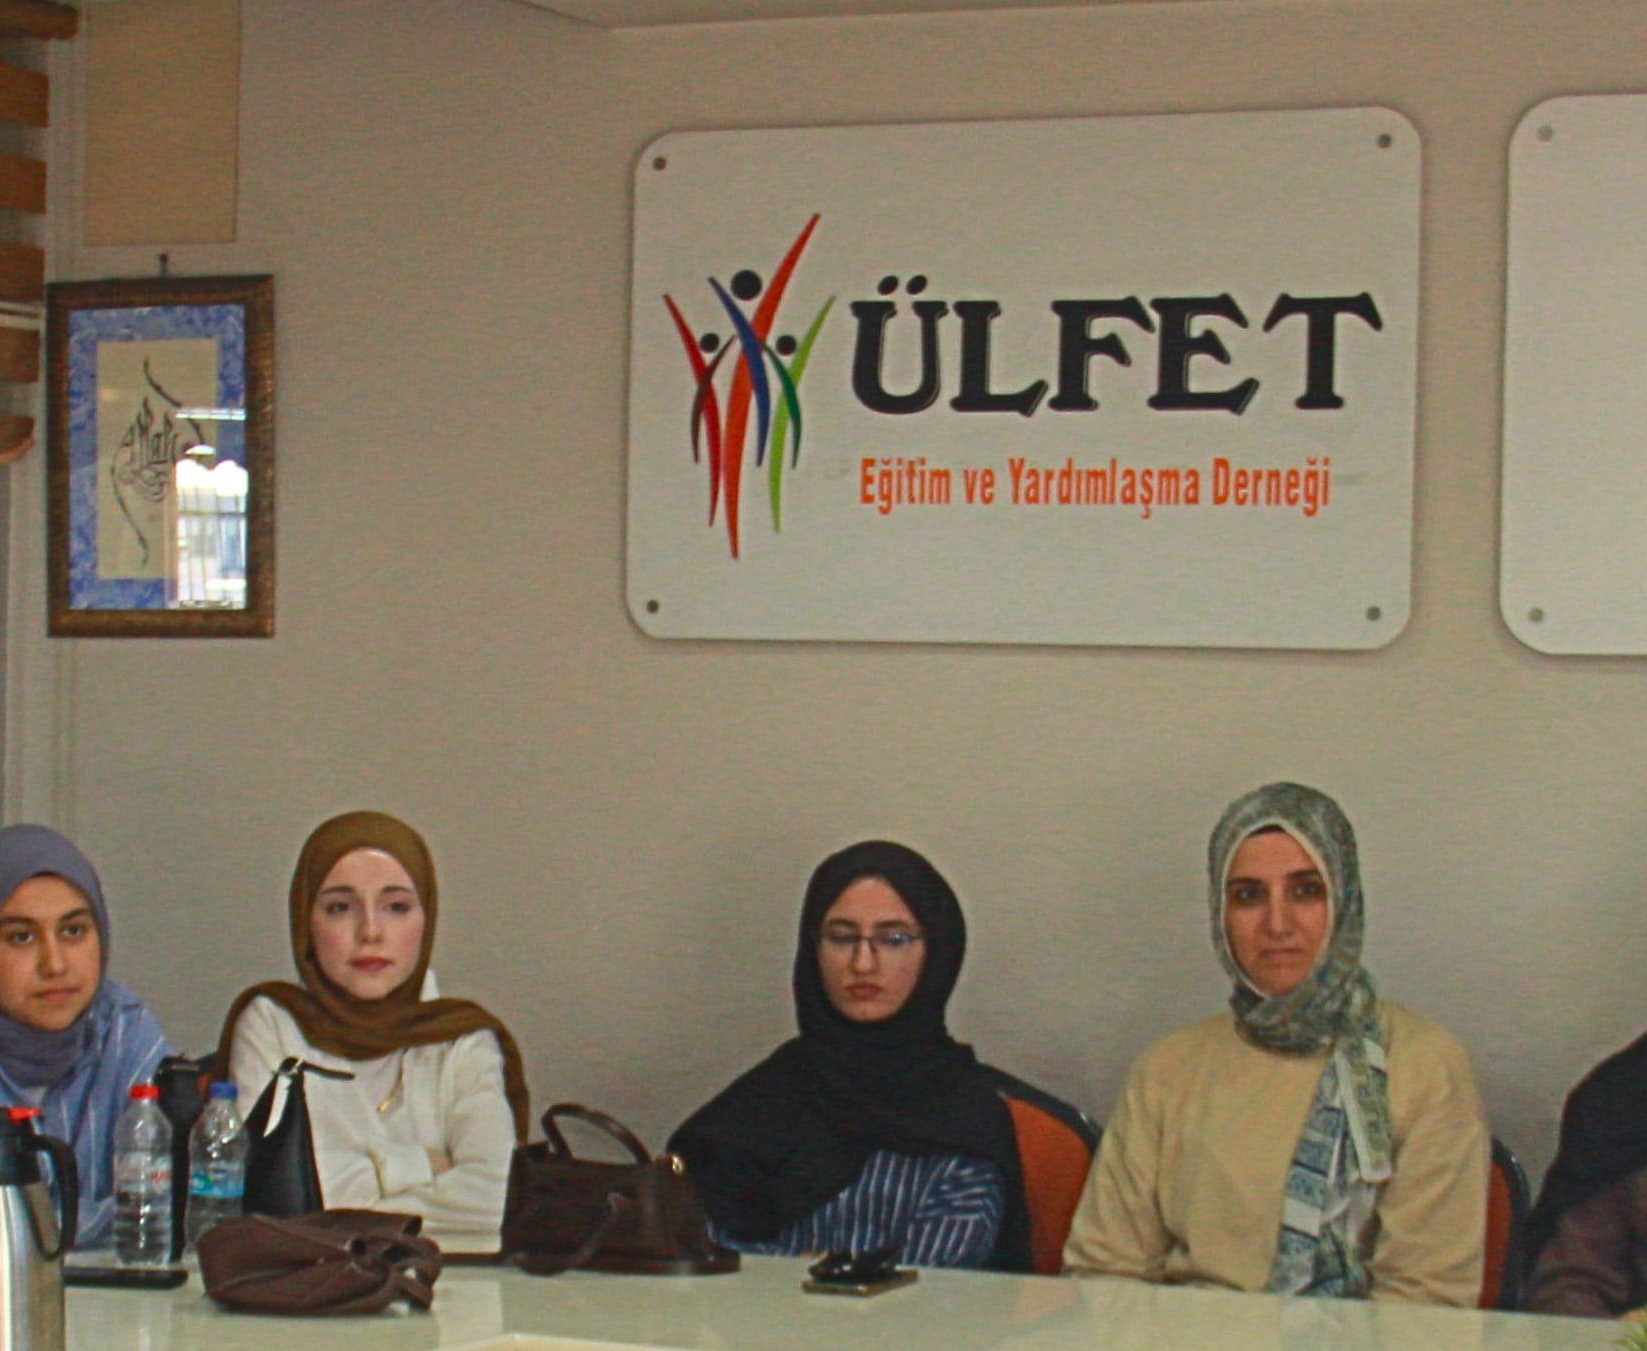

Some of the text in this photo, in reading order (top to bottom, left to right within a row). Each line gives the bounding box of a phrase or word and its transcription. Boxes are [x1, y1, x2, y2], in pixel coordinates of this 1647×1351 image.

[849, 274, 1384, 418] ÜLFET
[860, 456, 1331, 520] Eğitim ve Yardımlaşma Derneği
